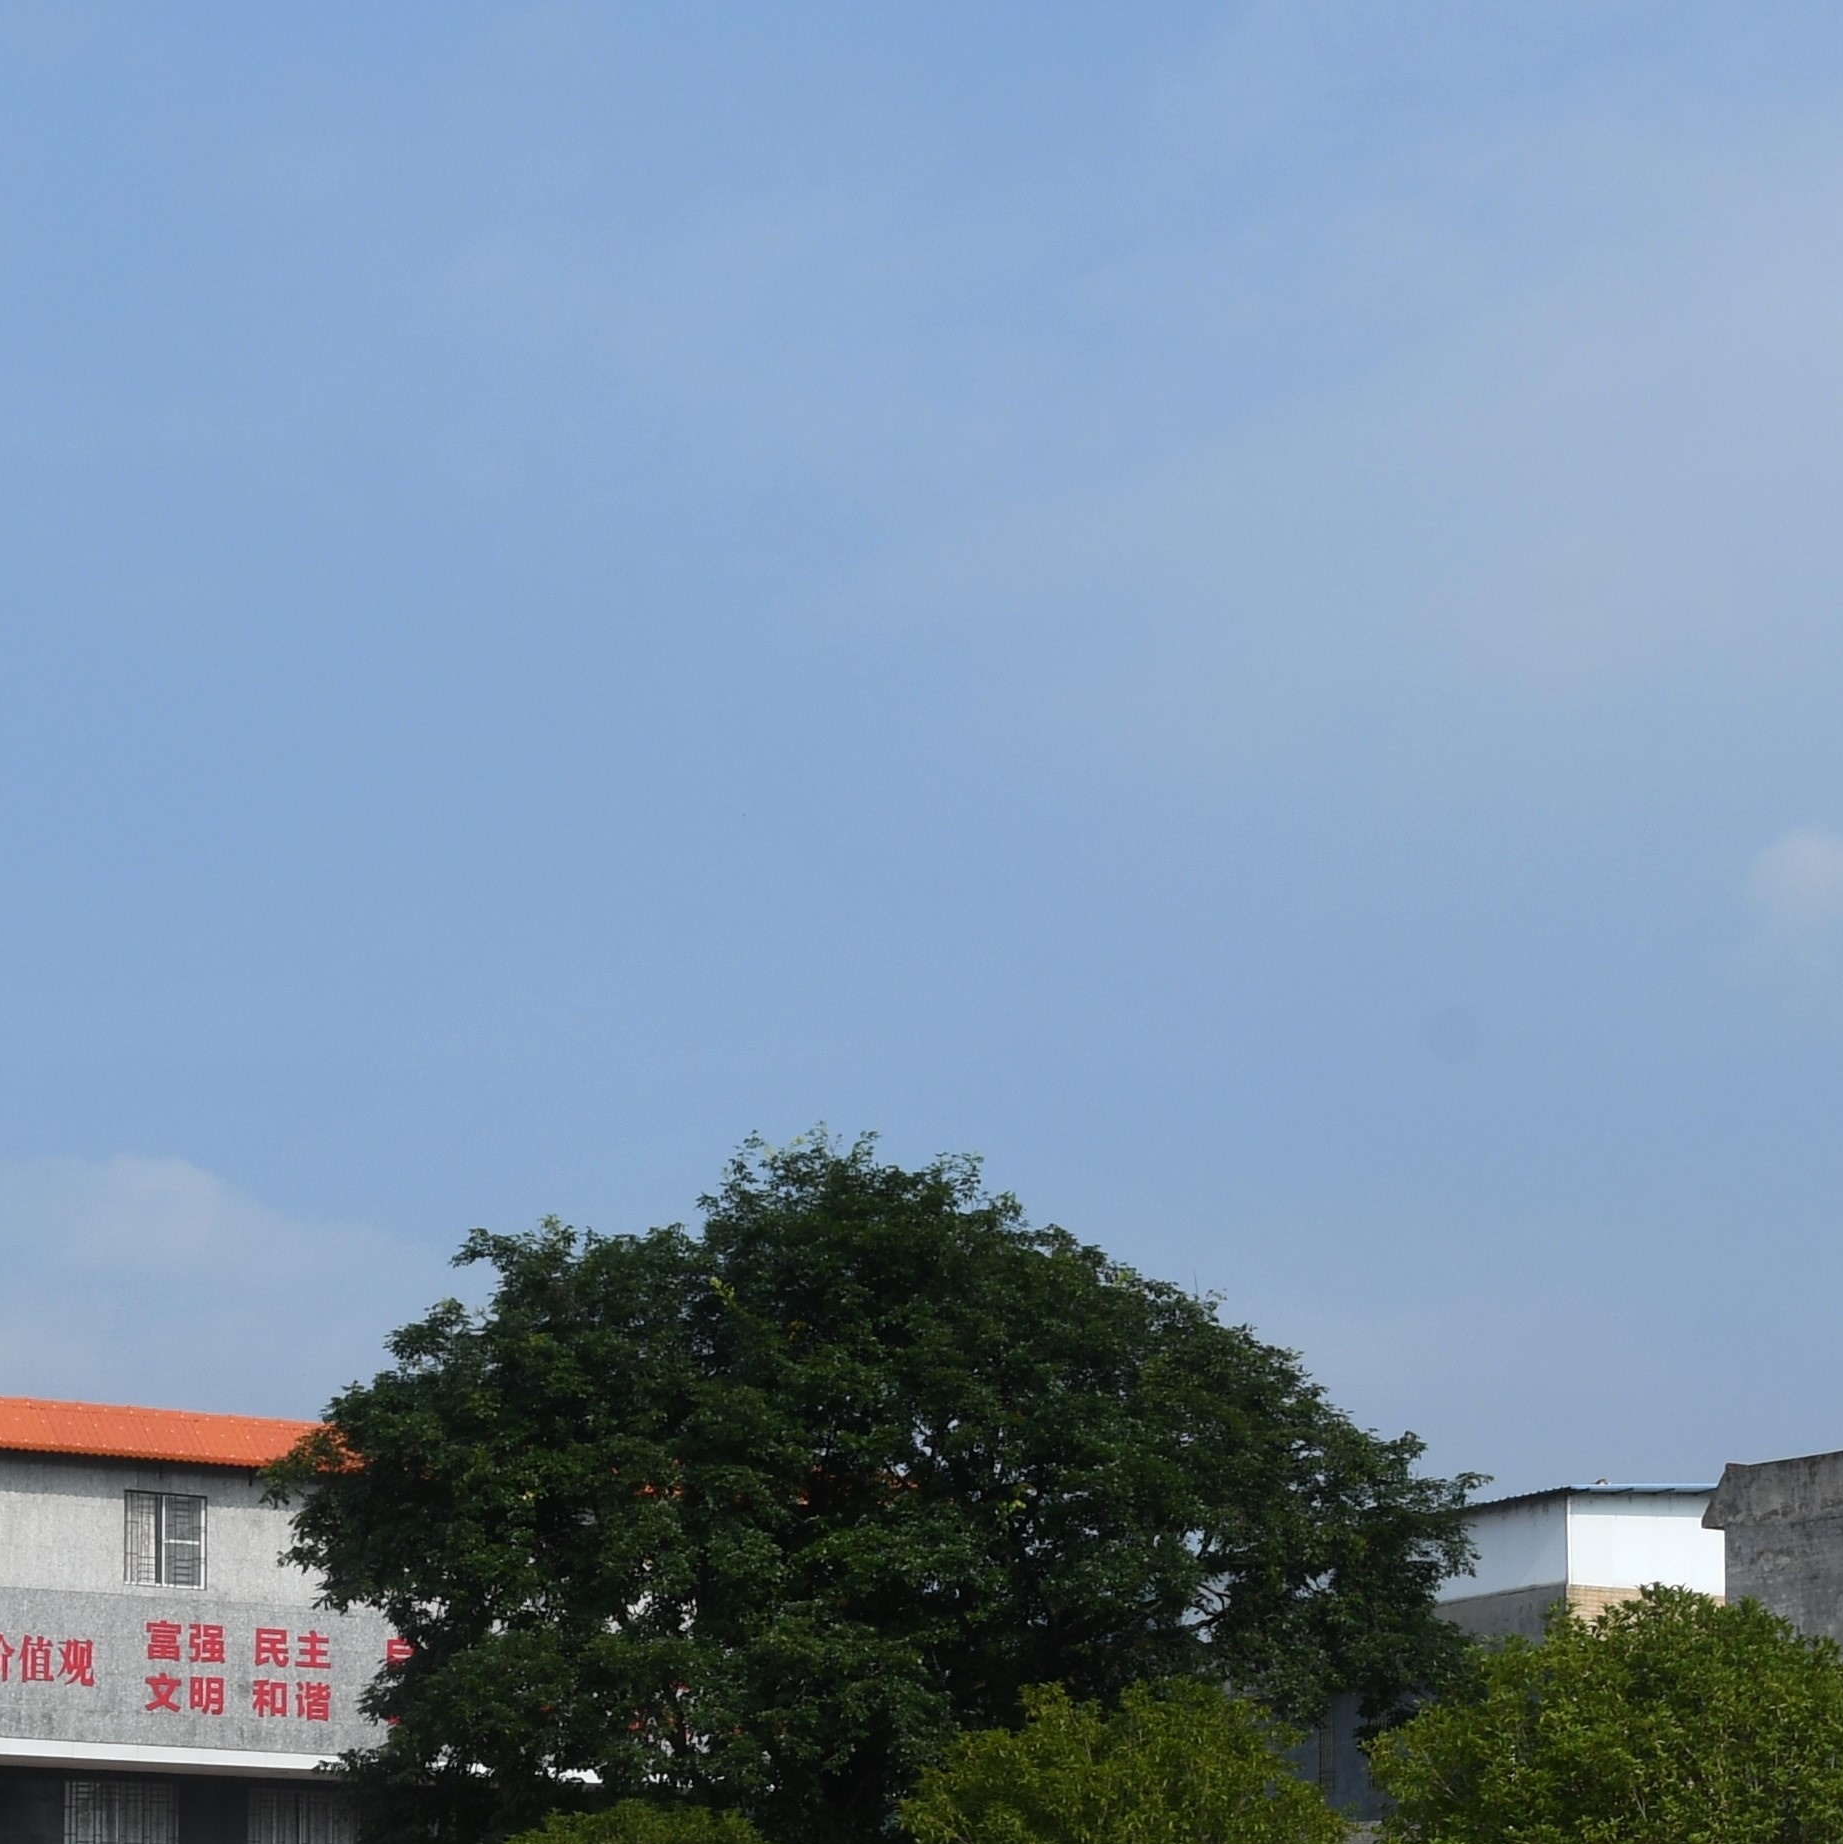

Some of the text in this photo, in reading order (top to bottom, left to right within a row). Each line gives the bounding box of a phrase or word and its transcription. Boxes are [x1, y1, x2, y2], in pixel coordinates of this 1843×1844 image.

[145, 1619, 332, 1670] 富强 民主
[144, 1673, 332, 1722] 文明 和谐
